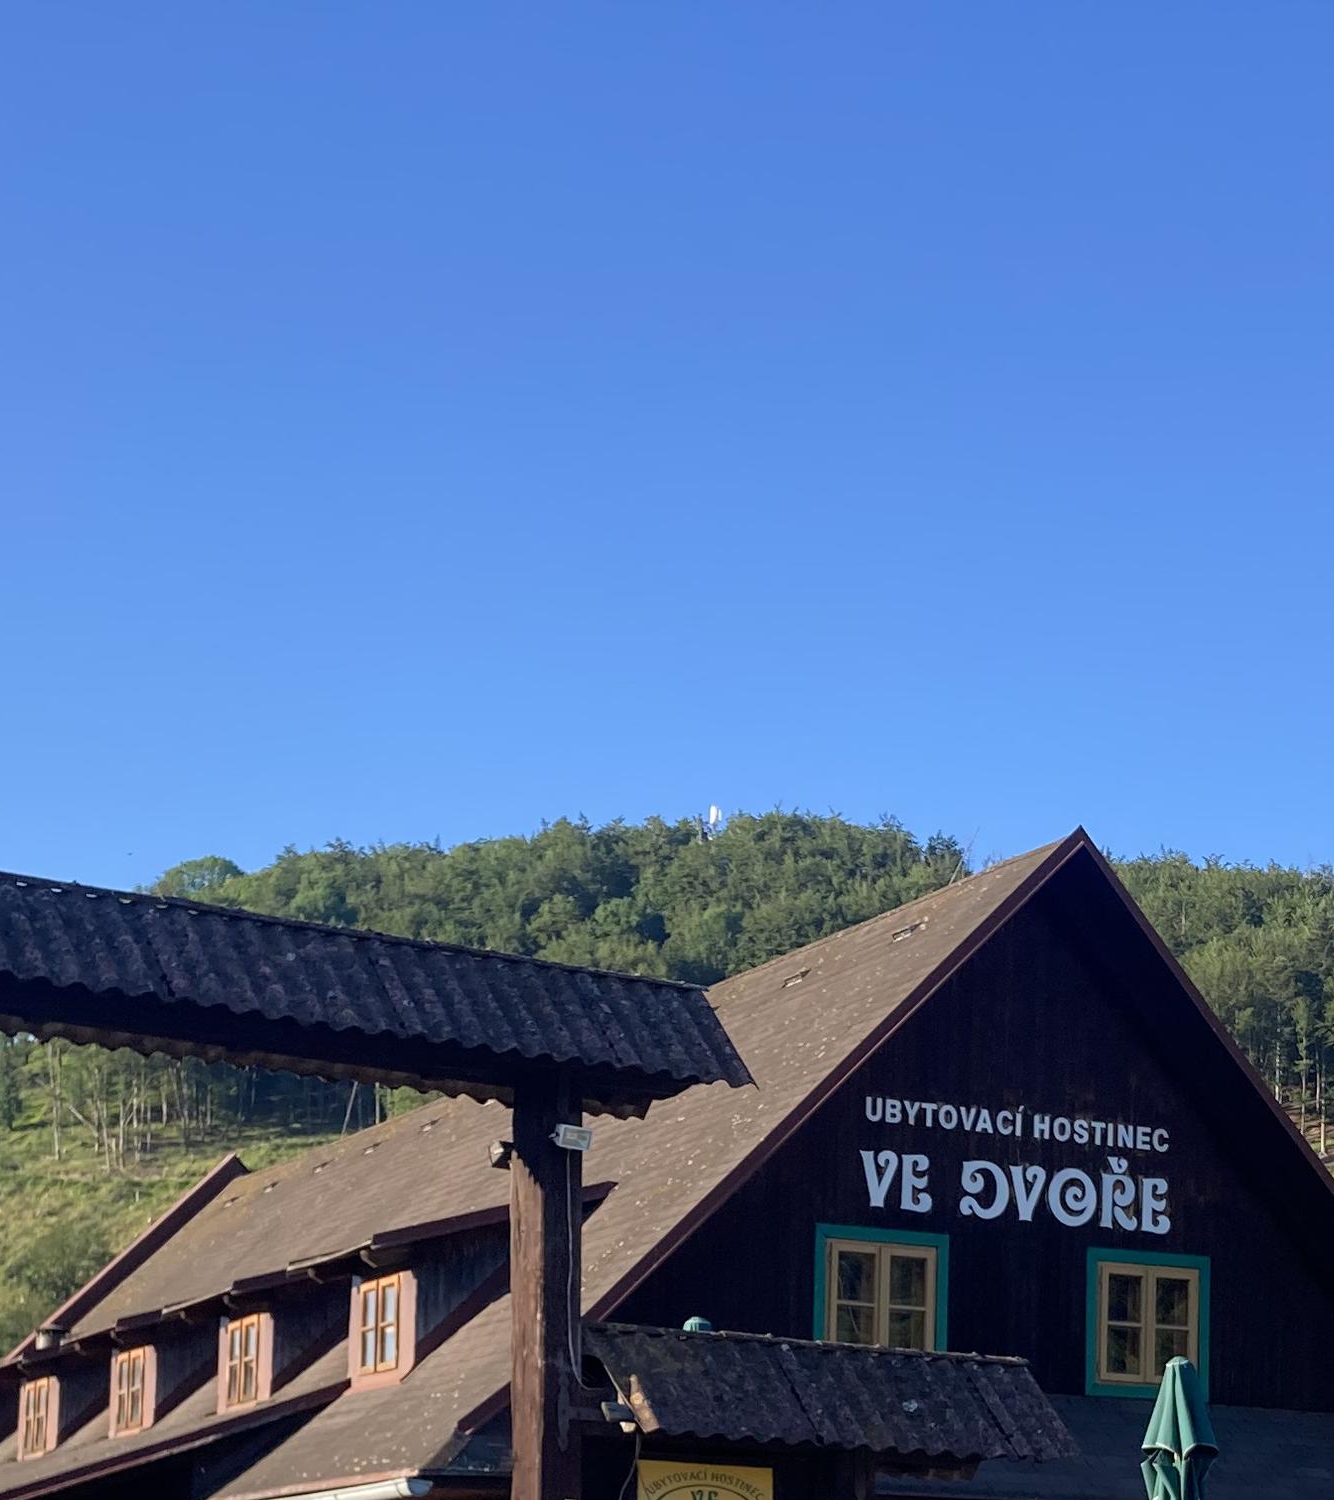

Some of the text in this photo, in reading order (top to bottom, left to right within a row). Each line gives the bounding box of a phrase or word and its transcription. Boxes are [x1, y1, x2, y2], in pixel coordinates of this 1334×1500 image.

[865, 1095, 1169, 1153] UBYTOVACÍ HOSTINEC
[859, 1149, 1171, 1235] VE DVOŘE
[645, 1468, 708, 1496] UBYTOVACÍ
